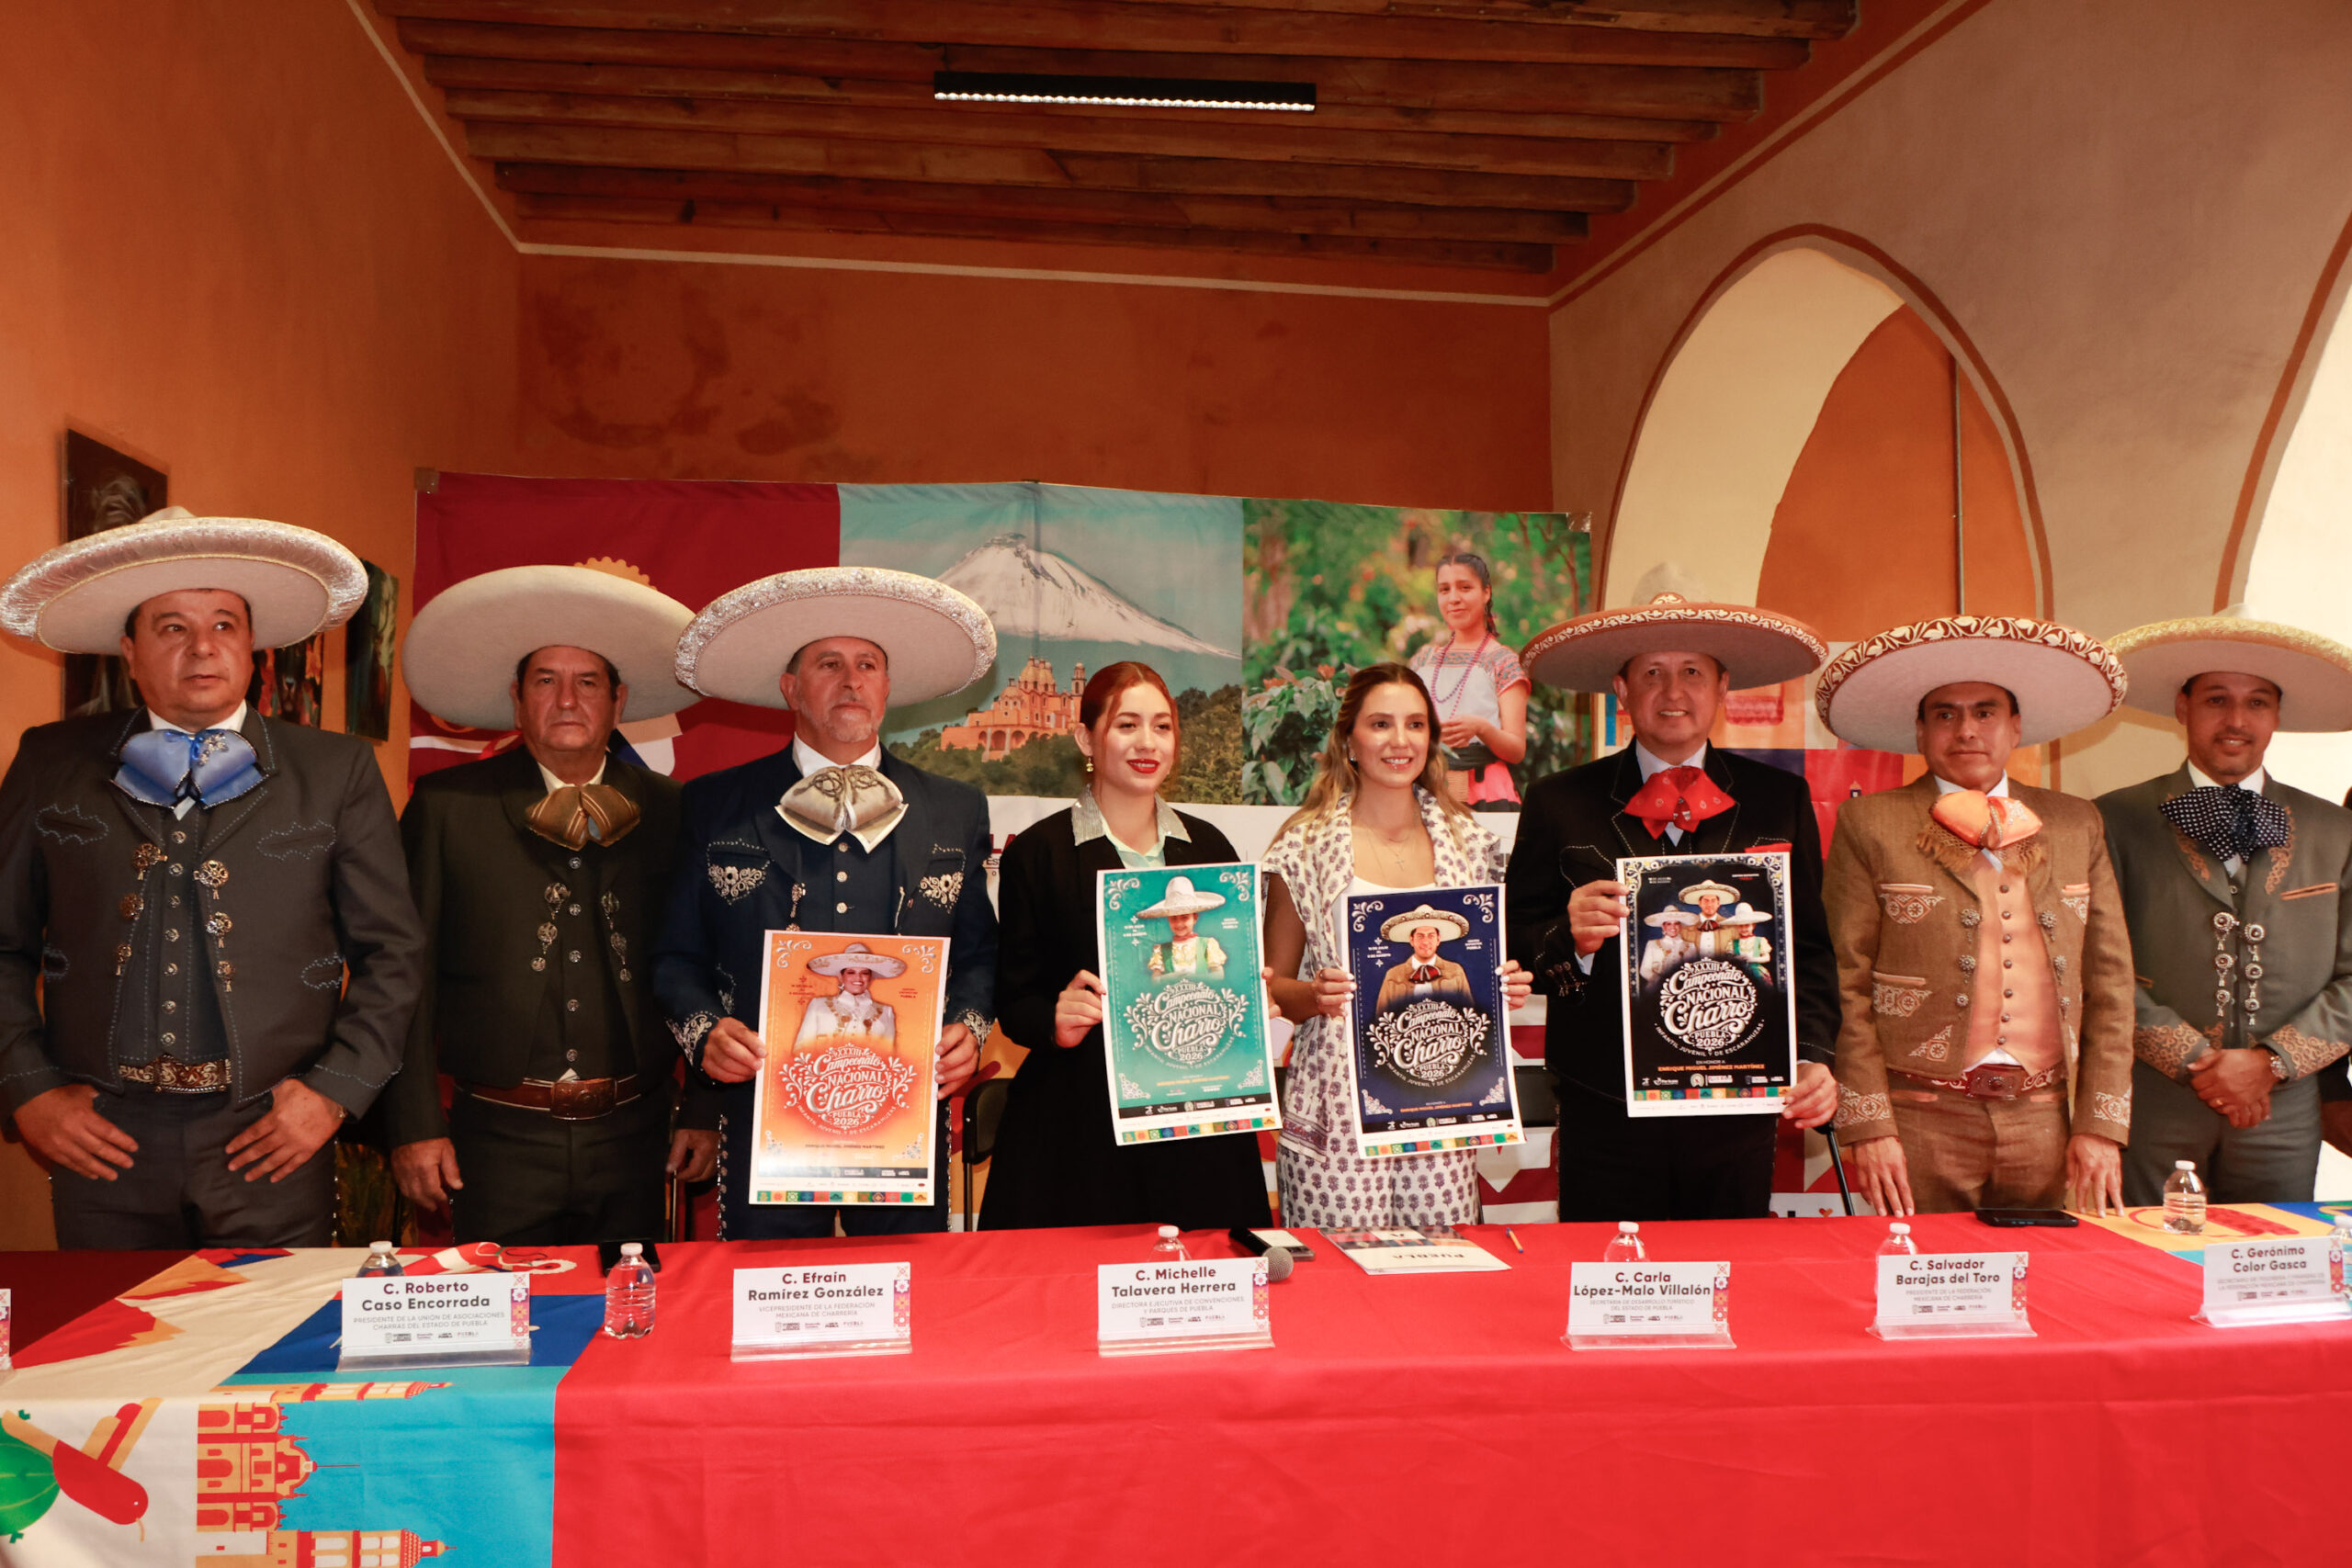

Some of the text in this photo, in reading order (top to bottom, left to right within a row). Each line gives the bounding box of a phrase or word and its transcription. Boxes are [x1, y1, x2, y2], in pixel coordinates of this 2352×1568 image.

[1669, 969, 1743, 995] Campeonato
[1155, 991, 1217, 1014] Campeonato
[1687, 986, 1747, 1007] NACIONAL
[1170, 1004, 1221, 1024] NACIONAL
[1396, 1010, 1458, 1032] Campeonato
[1665, 1000, 1747, 1035] Charro
[1151, 1018, 1221, 1052] Charro
[1412, 1022, 1463, 1043] NACIONAL
[1695, 1031, 1725, 1039] PUEBLA
[1696, 1038, 1724, 1047] 2026
[1394, 1037, 1462, 1069] Charro
[813, 1054, 882, 1076] Campeonato
[828, 1071, 885, 1087] NACIONAL
[1420, 1070, 1444, 1078] 2026
[806, 1081, 884, 1113] Charro
[833, 1117, 859, 1125] 2026
[2231, 1246, 2305, 1259] C. Gerónimo
[1909, 1259, 1984, 1270] C. Salvador
[2233, 1259, 2307, 1272] Color Gasca
[782, 1271, 846, 1284] C. Efraín
[1136, 1267, 1216, 1280] C. Michelle
[1615, 1271, 1671, 1282] C. Carla
[1896, 1273, 2000, 1287] Barajas del Toro
[383, 1281, 469, 1294] C. Roberto
[749, 1285, 883, 1301] Ramírez González
[1112, 1282, 1236, 1297] Talavera Herrera
[1574, 1284, 1711, 1298] López-Malo Villalón
[362, 1296, 490, 1311] Caso Encorrada
